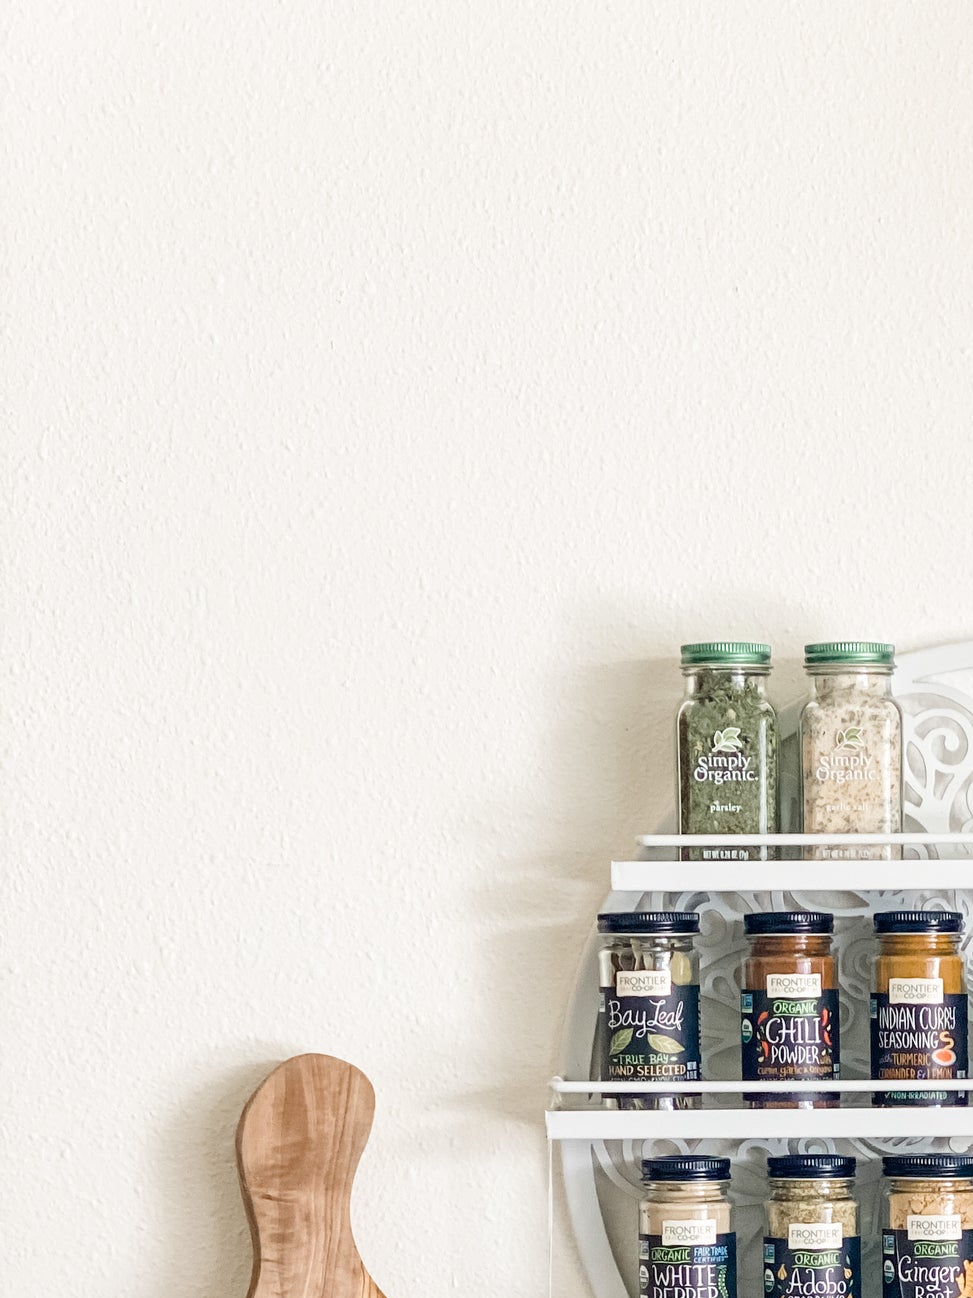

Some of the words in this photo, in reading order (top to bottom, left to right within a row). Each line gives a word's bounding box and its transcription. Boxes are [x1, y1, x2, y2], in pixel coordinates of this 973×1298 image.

[697, 753, 751, 773] Simply
[819, 753, 872, 773] Simply
[710, 801, 742, 813] parsley
[620, 976, 666, 985] FRONTIER
[771, 977, 818, 987] FRONTIER
[892, 984, 938, 993] FRONTIER
[773, 1002, 817, 1014] ORGANIC
[608, 1000, 656, 1037] Bay
[647, 999, 684, 1031] Leaf
[879, 1007, 916, 1030] INDIAN
[920, 1007, 956, 1030] CURRY
[766, 1017, 821, 1044] CHILI
[879, 1031, 939, 1049] SEASONING
[619, 1054, 646, 1064] TRUE
[648, 1053, 669, 1064] BAY
[771, 1045, 820, 1064] POWDER
[892, 1053, 931, 1065] TURMERIC
[609, 1064, 633, 1076] HAND
[637, 1064, 686, 1076] SELECTED
[665, 1226, 711, 1234] FRONTIER
[911, 1220, 957, 1229] FRONTIER
[791, 1229, 837, 1237] FRONTIER
[651, 1249, 691, 1261] ORGANIC
[694, 1246, 710, 1256] FAIR
[914, 1245, 958, 1255] ORGANIC
[795, 1253, 840, 1266] ORGANIC
[652, 1264, 717, 1287] WHITE
[898, 1255, 960, 1291] Ginger
[786, 1268, 847, 1295] Adobo
